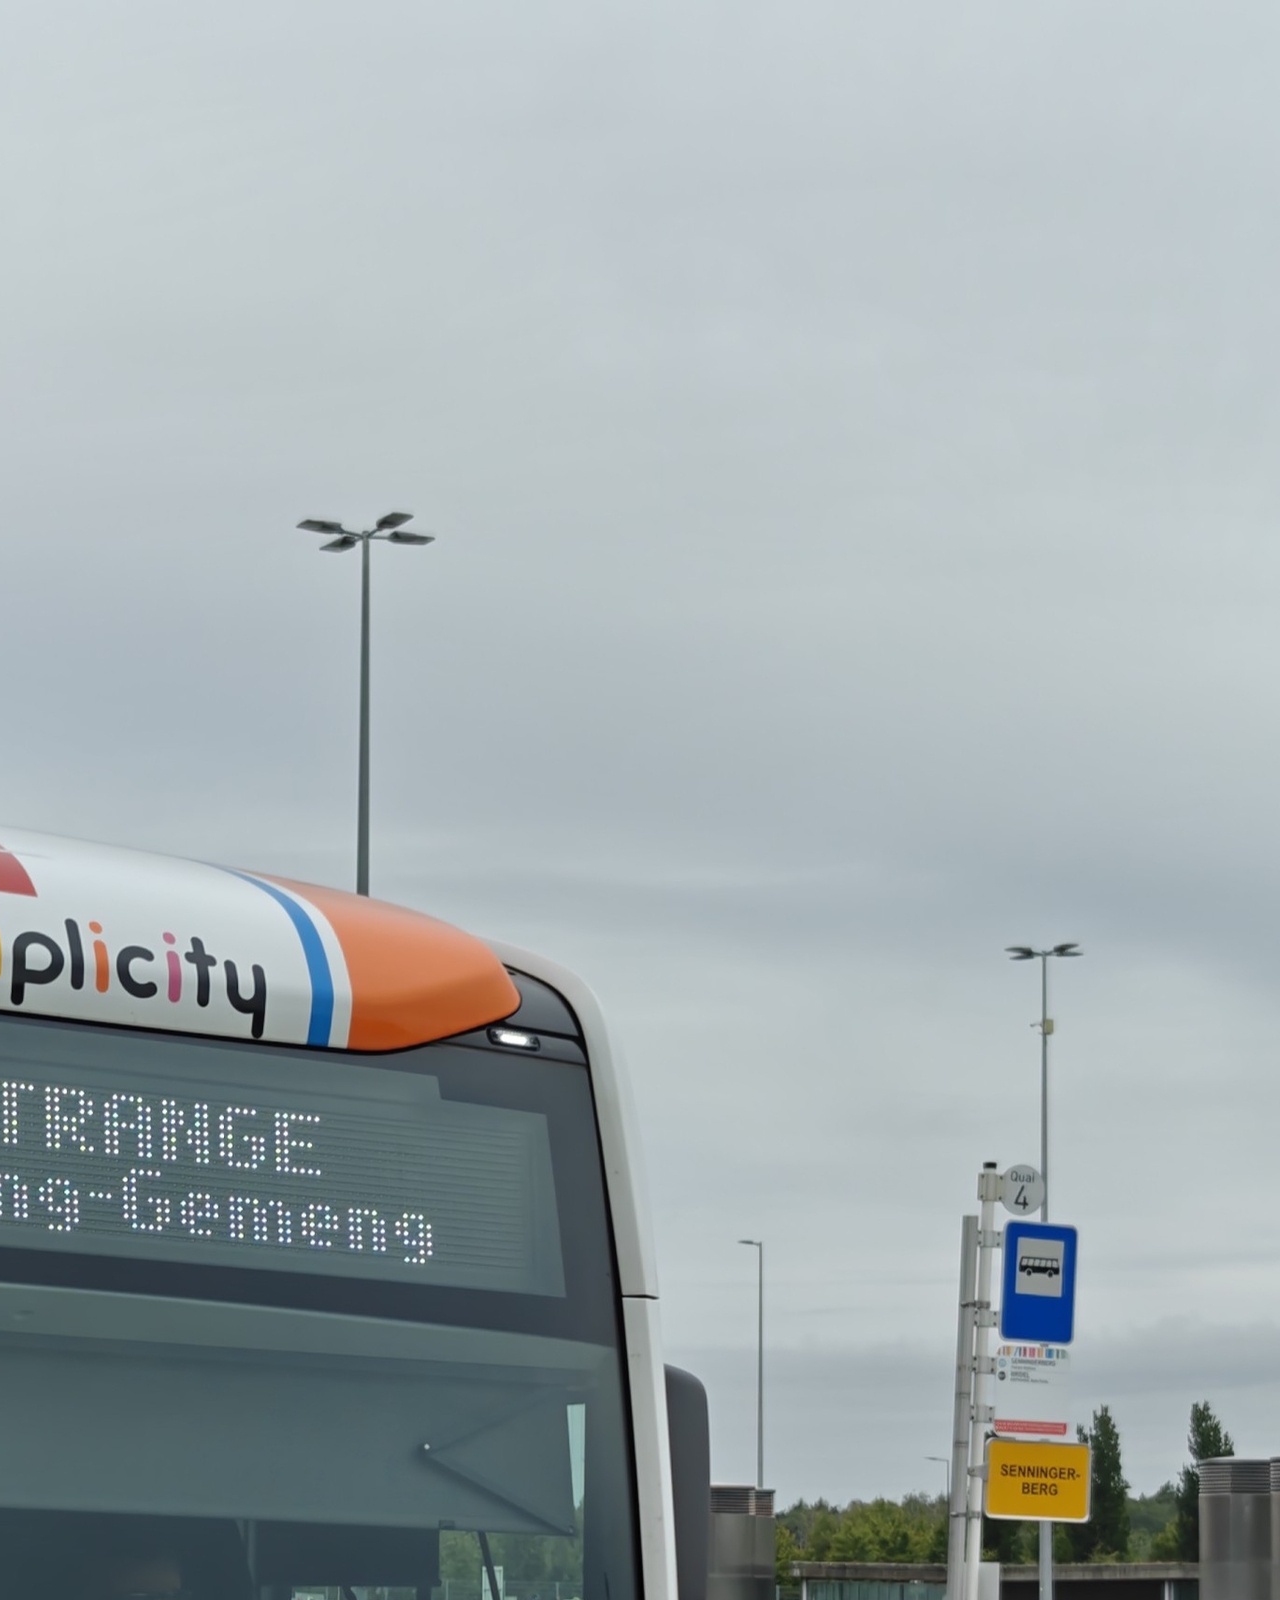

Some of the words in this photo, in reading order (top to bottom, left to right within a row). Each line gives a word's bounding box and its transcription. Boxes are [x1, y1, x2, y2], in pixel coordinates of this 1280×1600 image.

[1010, 1170, 1035, 1183] Quai
[1013, 1184, 1029, 1210] 4
[1000, 1464, 1081, 1481] SENNINGER-
[1021, 1482, 1058, 1496] BERG
